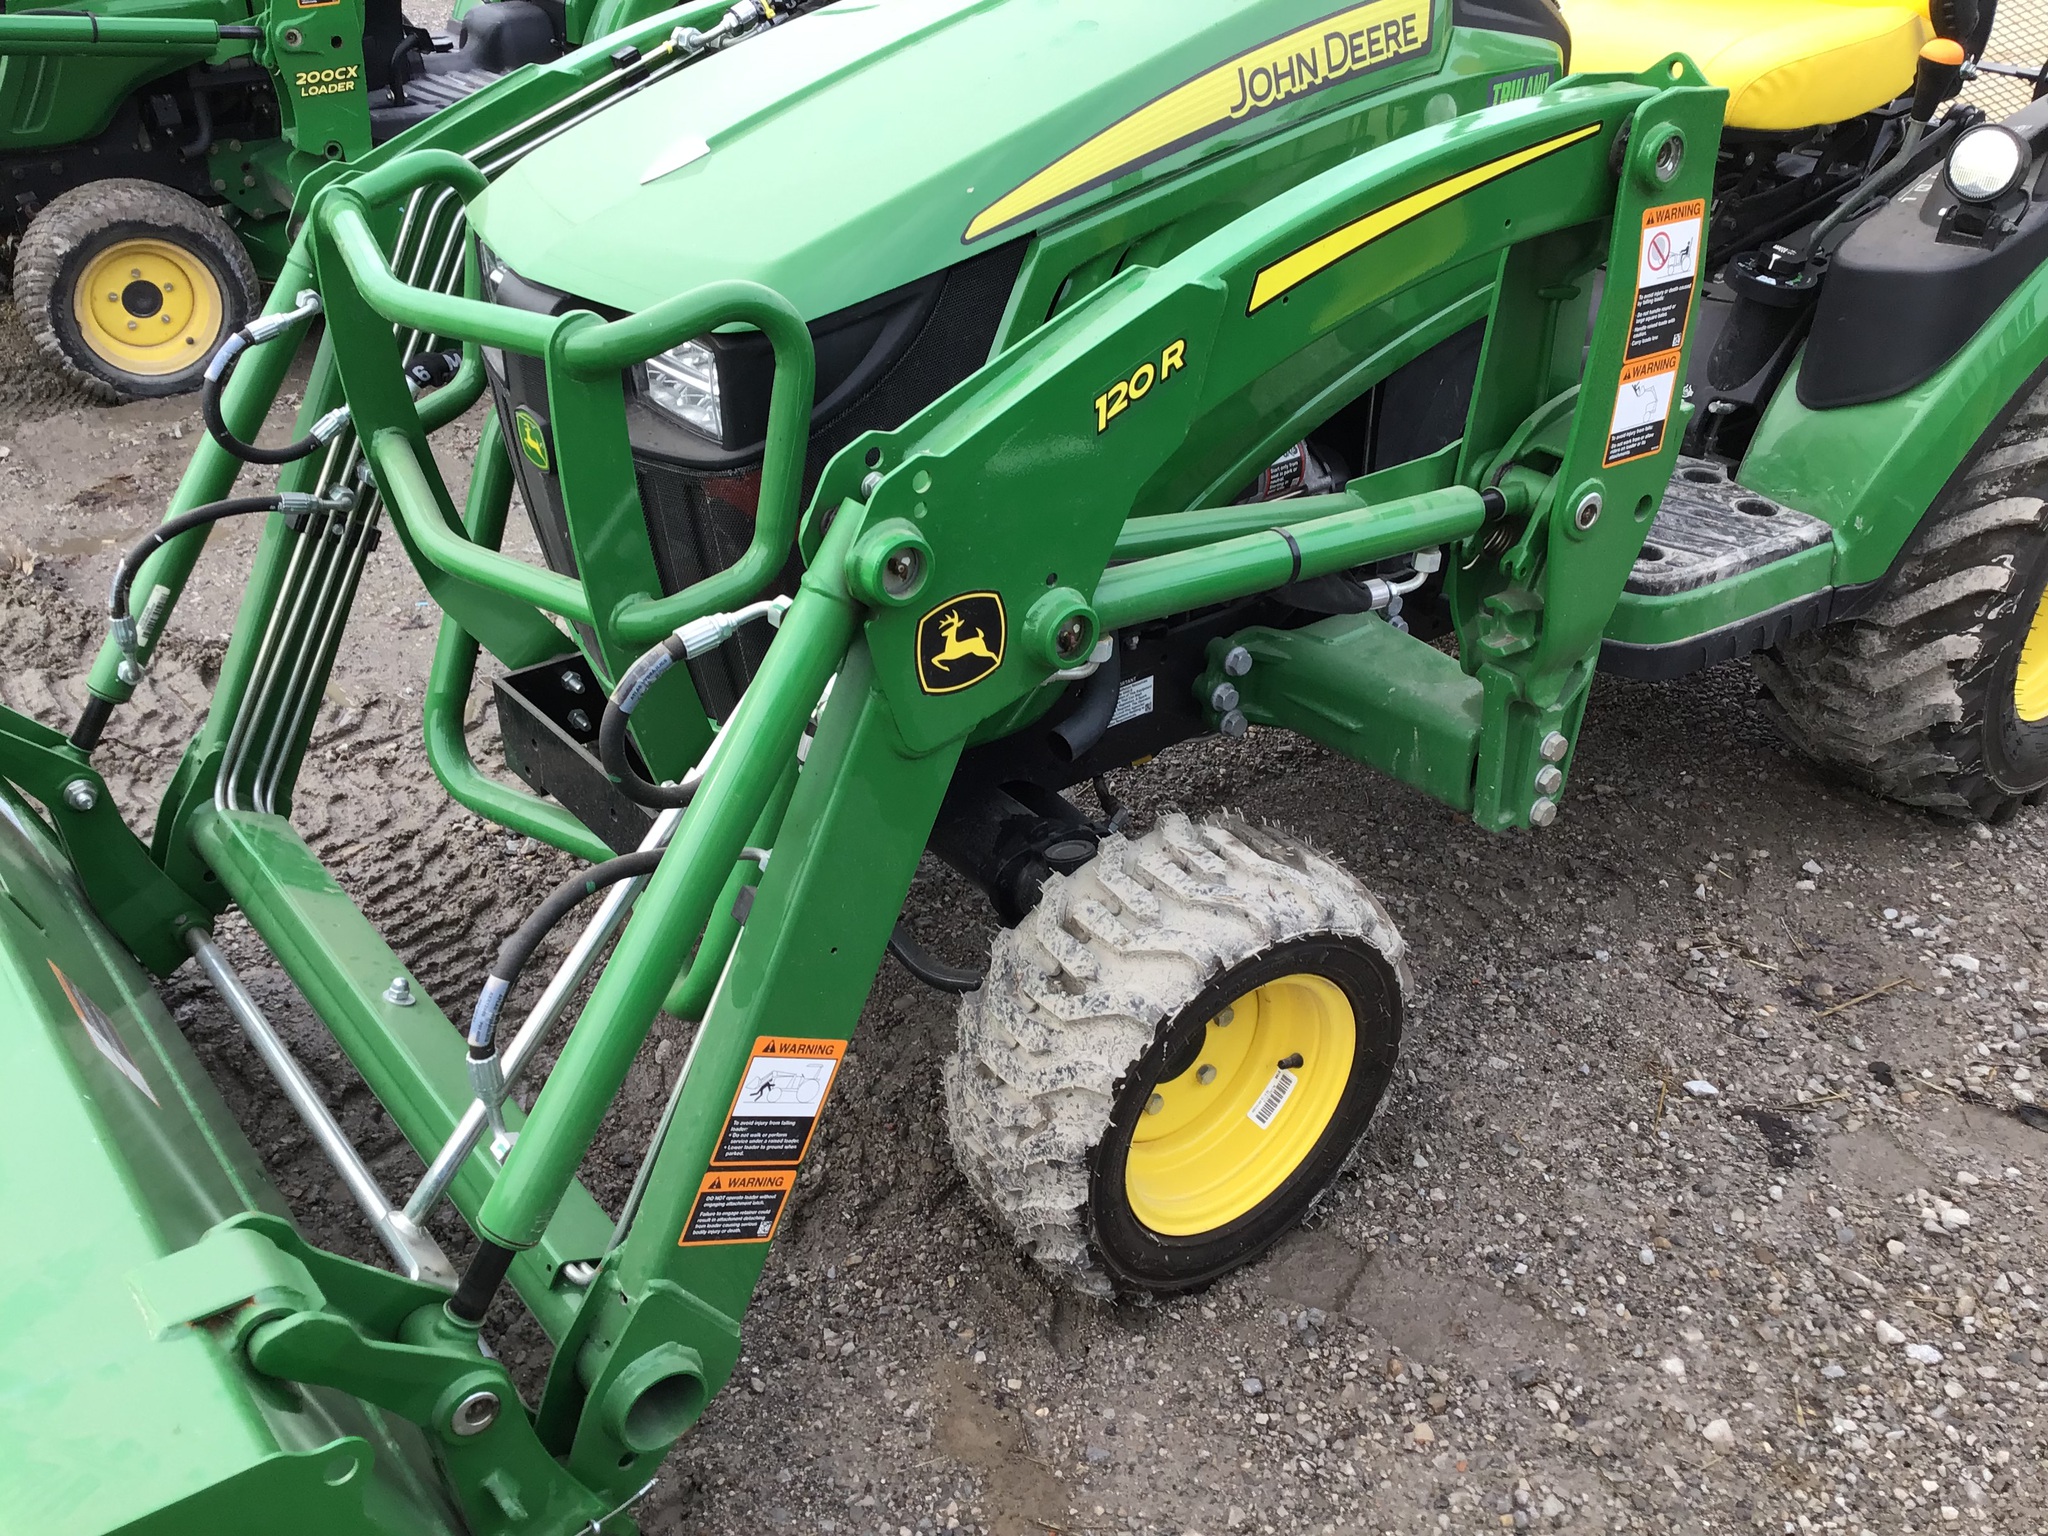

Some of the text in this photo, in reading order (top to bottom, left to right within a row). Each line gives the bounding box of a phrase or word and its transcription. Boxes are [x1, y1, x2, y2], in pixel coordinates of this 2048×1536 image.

[1230, 13, 1419, 114] JOHN DEERE
[296, 65, 358, 85] 200CX
[301, 81, 355, 97] LOADER
[1655, 202, 1701, 223] WARNING
[1632, 355, 1677, 378] WARNING
[1094, 338, 1187, 435] 120 R
[779, 1043, 835, 1055] WARNING
[728, 1176, 784, 1188] WARNING
